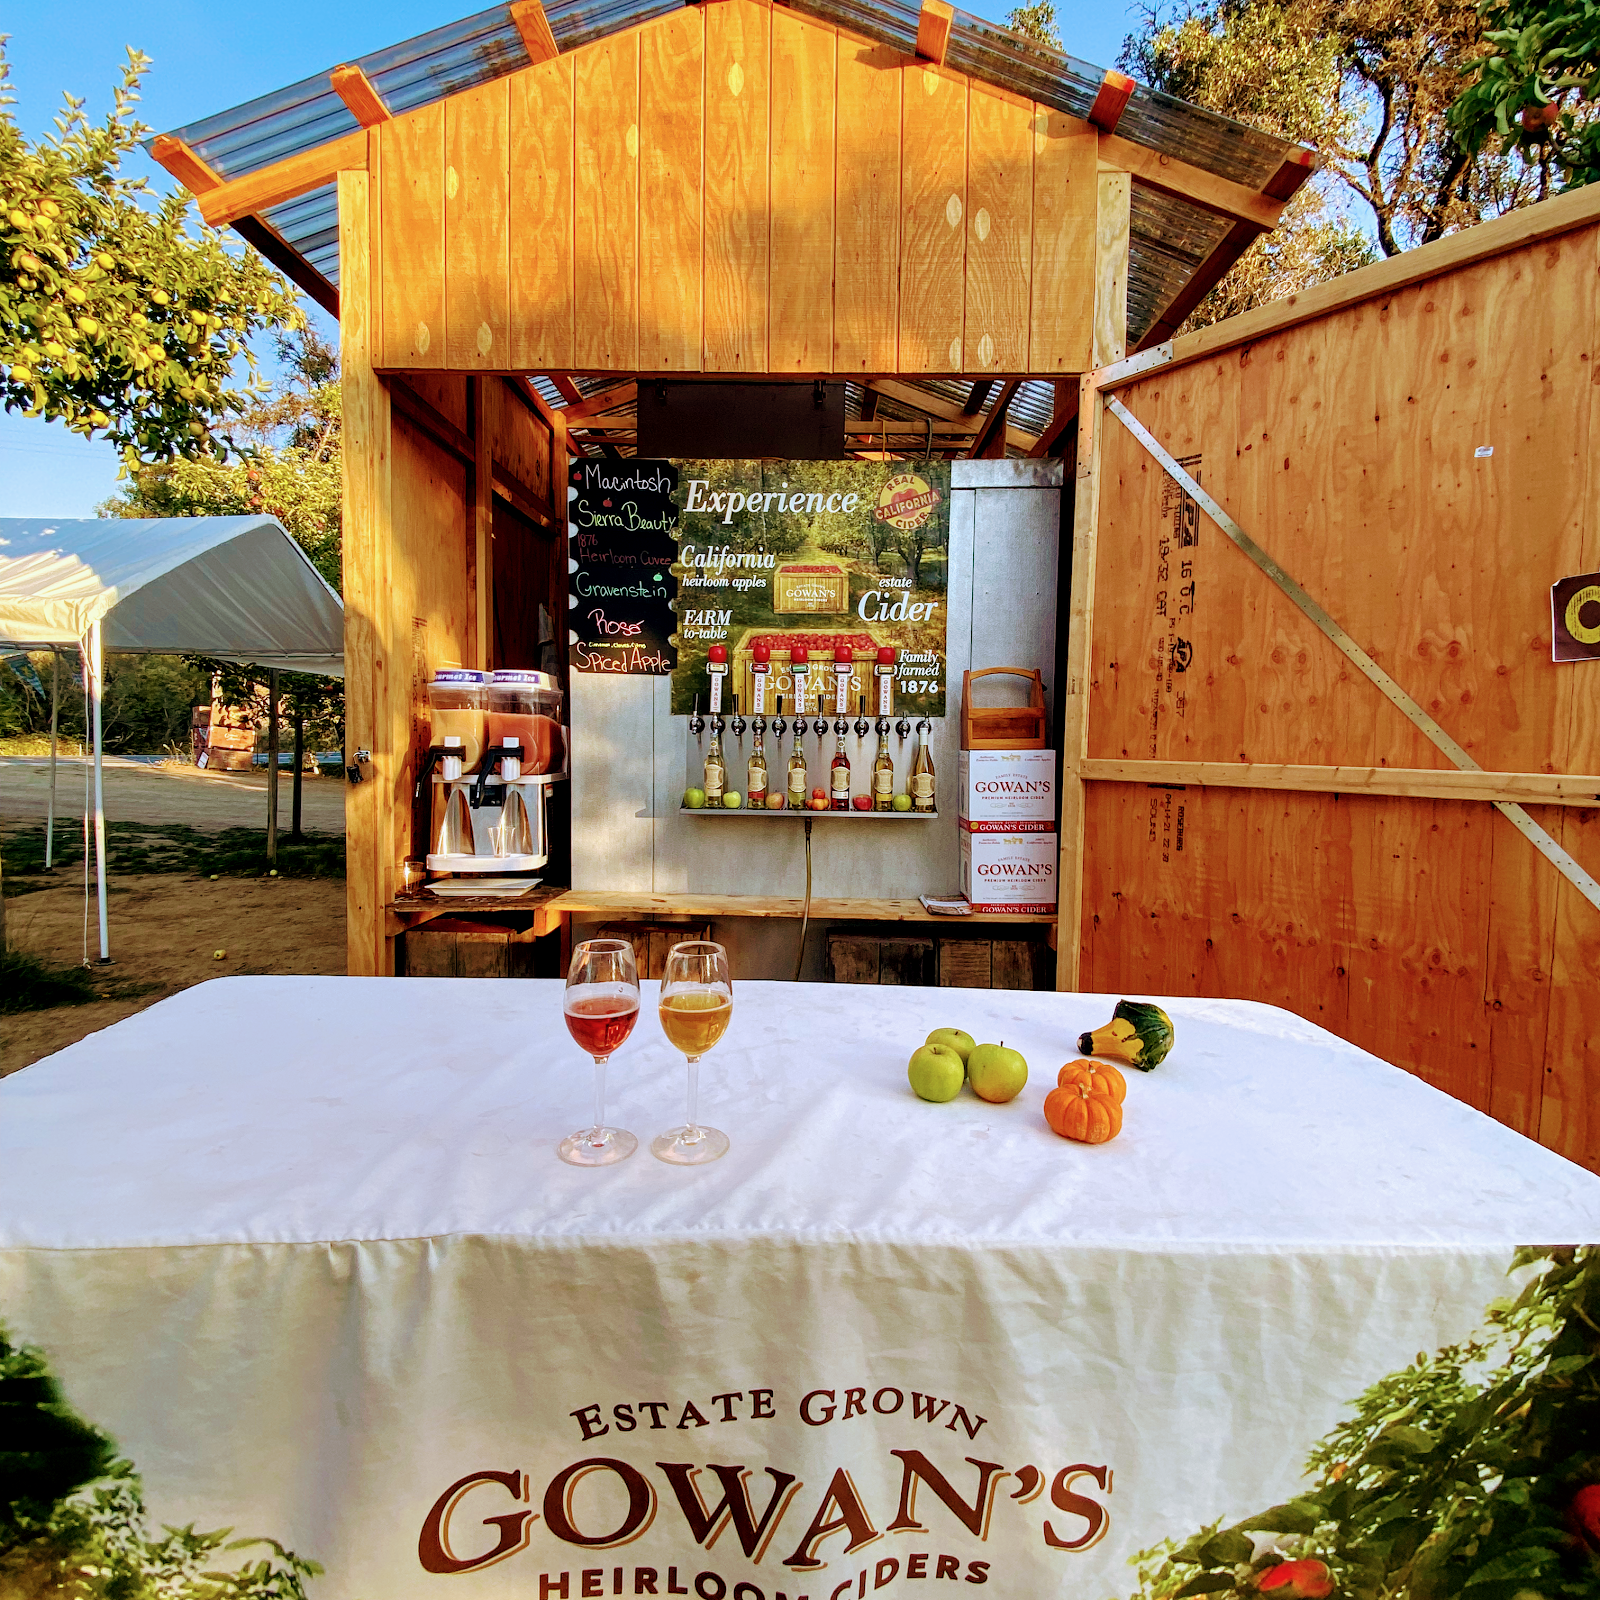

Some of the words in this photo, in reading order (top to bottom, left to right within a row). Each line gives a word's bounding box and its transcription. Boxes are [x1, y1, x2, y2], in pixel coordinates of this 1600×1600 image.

[585, 463, 671, 494] Macintosh
[886, 475, 915, 491] REAL
[683, 479, 859, 525] Experience
[875, 491, 940, 520] CALIFORNIA
[578, 500, 624, 527] Sierra
[621, 501, 677, 534] Beauty
[895, 511, 928, 529] CIDER
[577, 534, 599, 547] 1876
[579, 548, 637, 565] Heirloom
[640, 550, 672, 566] Cuvee
[681, 545, 776, 575] California
[576, 571, 667, 598] Gravenstein
[682, 575, 729, 588] heirloom
[732, 576, 767, 591] apples
[879, 577, 913, 588] estate
[786, 589, 836, 598] GOWAN'S
[857, 590, 939, 622] Cider
[683, 610, 733, 626] FARM
[683, 627, 728, 640] to-table
[576, 641, 627, 673] Spiced
[630, 644, 672, 673] Apple
[899, 650, 939, 666] Family
[464, 673, 477, 681] Ice
[896, 662, 940, 681] farmed
[900, 680, 939, 694] 1876
[975, 780, 1051, 793] GOWAN'S
[979, 823, 1018, 831] GOWAN'S
[1018, 823, 1045, 831] CIDER
[977, 863, 1052, 876] GOWAN'S
[570, 1388, 777, 1441] ESTATE
[799, 1387, 989, 1440] GROWN
[417, 1448, 1115, 1575] GOWAN'S
[829, 1553, 991, 1600] CIDERS
